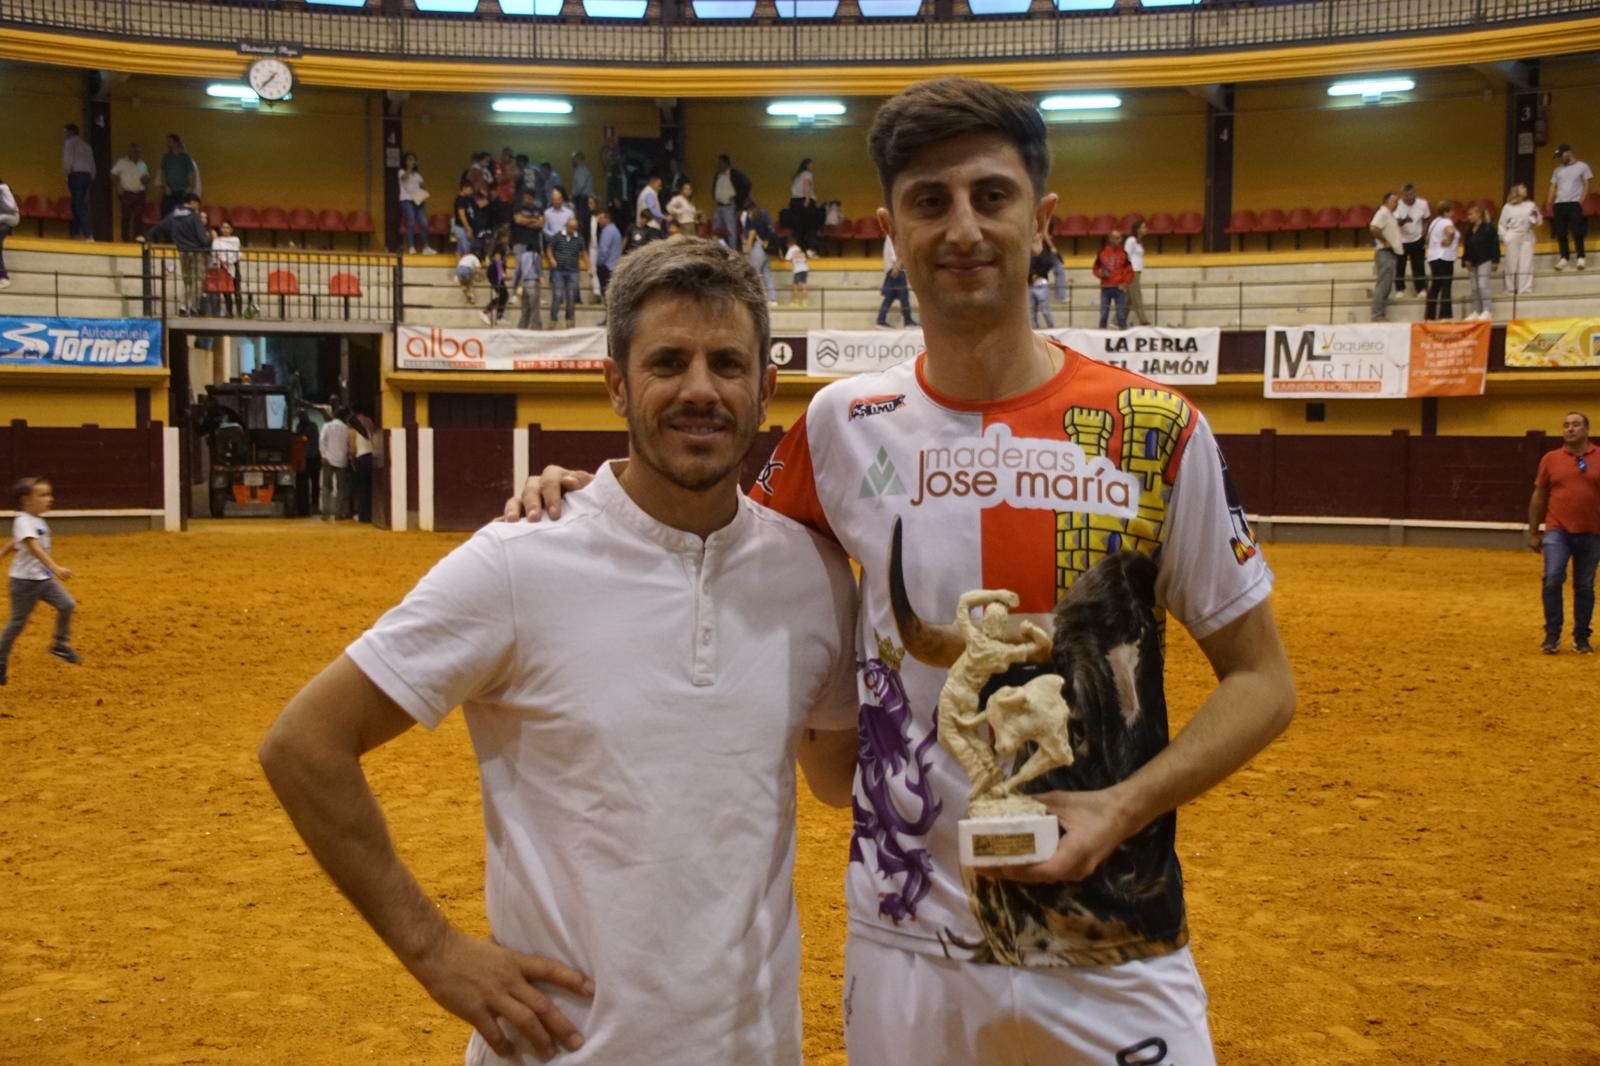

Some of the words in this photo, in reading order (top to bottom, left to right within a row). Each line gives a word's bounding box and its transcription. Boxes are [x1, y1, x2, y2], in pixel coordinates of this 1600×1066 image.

[1219, 127, 1229, 142] 4
[80, 325, 150, 340] Autoescuela
[48, 328, 150, 363] Tormes
[405, 326, 484, 359] alba
[1105, 337, 1129, 352] LA
[1135, 337, 1198, 353] PERLA
[775, 345, 786, 362] 4
[1139, 356, 1210, 375] JAMÓN
[926, 433, 1076, 473] maderas
[1015, 467, 1130, 508] maría
